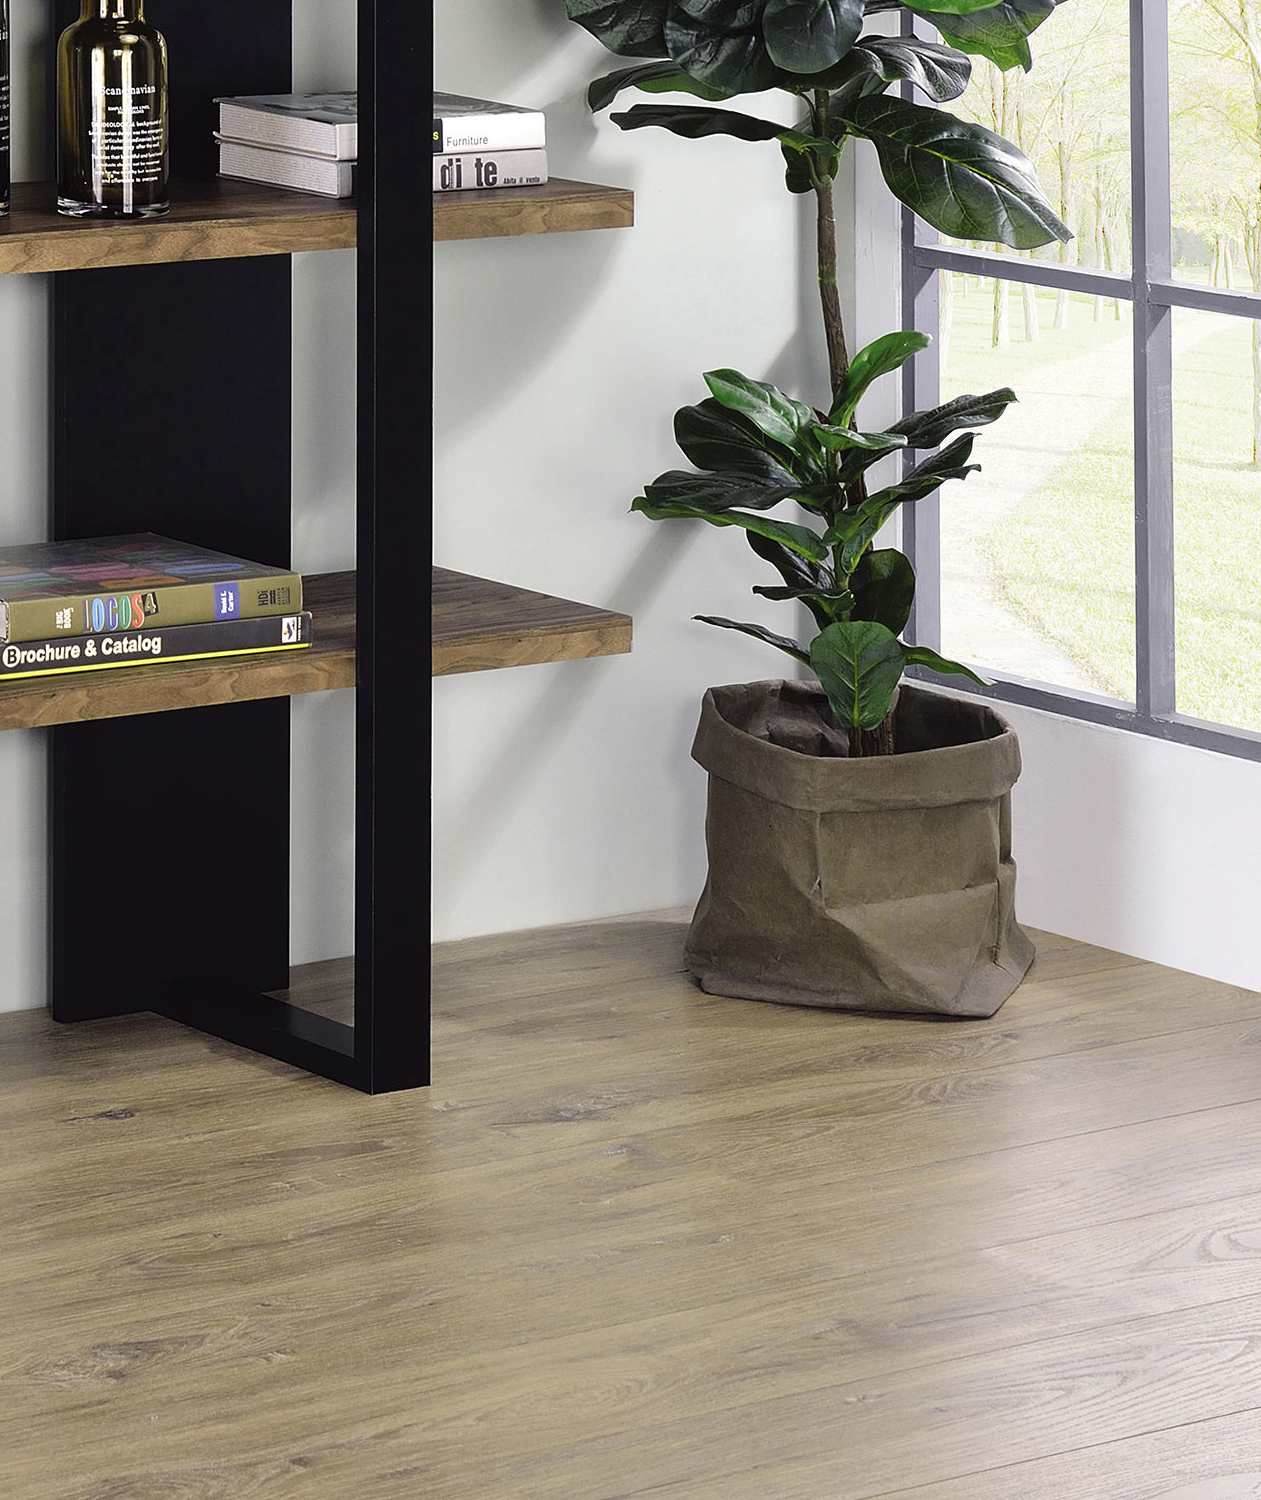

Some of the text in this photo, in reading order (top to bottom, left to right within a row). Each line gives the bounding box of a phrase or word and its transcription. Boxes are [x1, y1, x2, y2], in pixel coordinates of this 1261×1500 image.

[446, 136, 489, 147] Furniture
[441, 158, 462, 190] di
[475, 157, 497, 187] te
[220, 597, 228, 614] David
[56, 611, 64, 625] BIG
[2, 635, 162, 668] Brochure & Catalog
